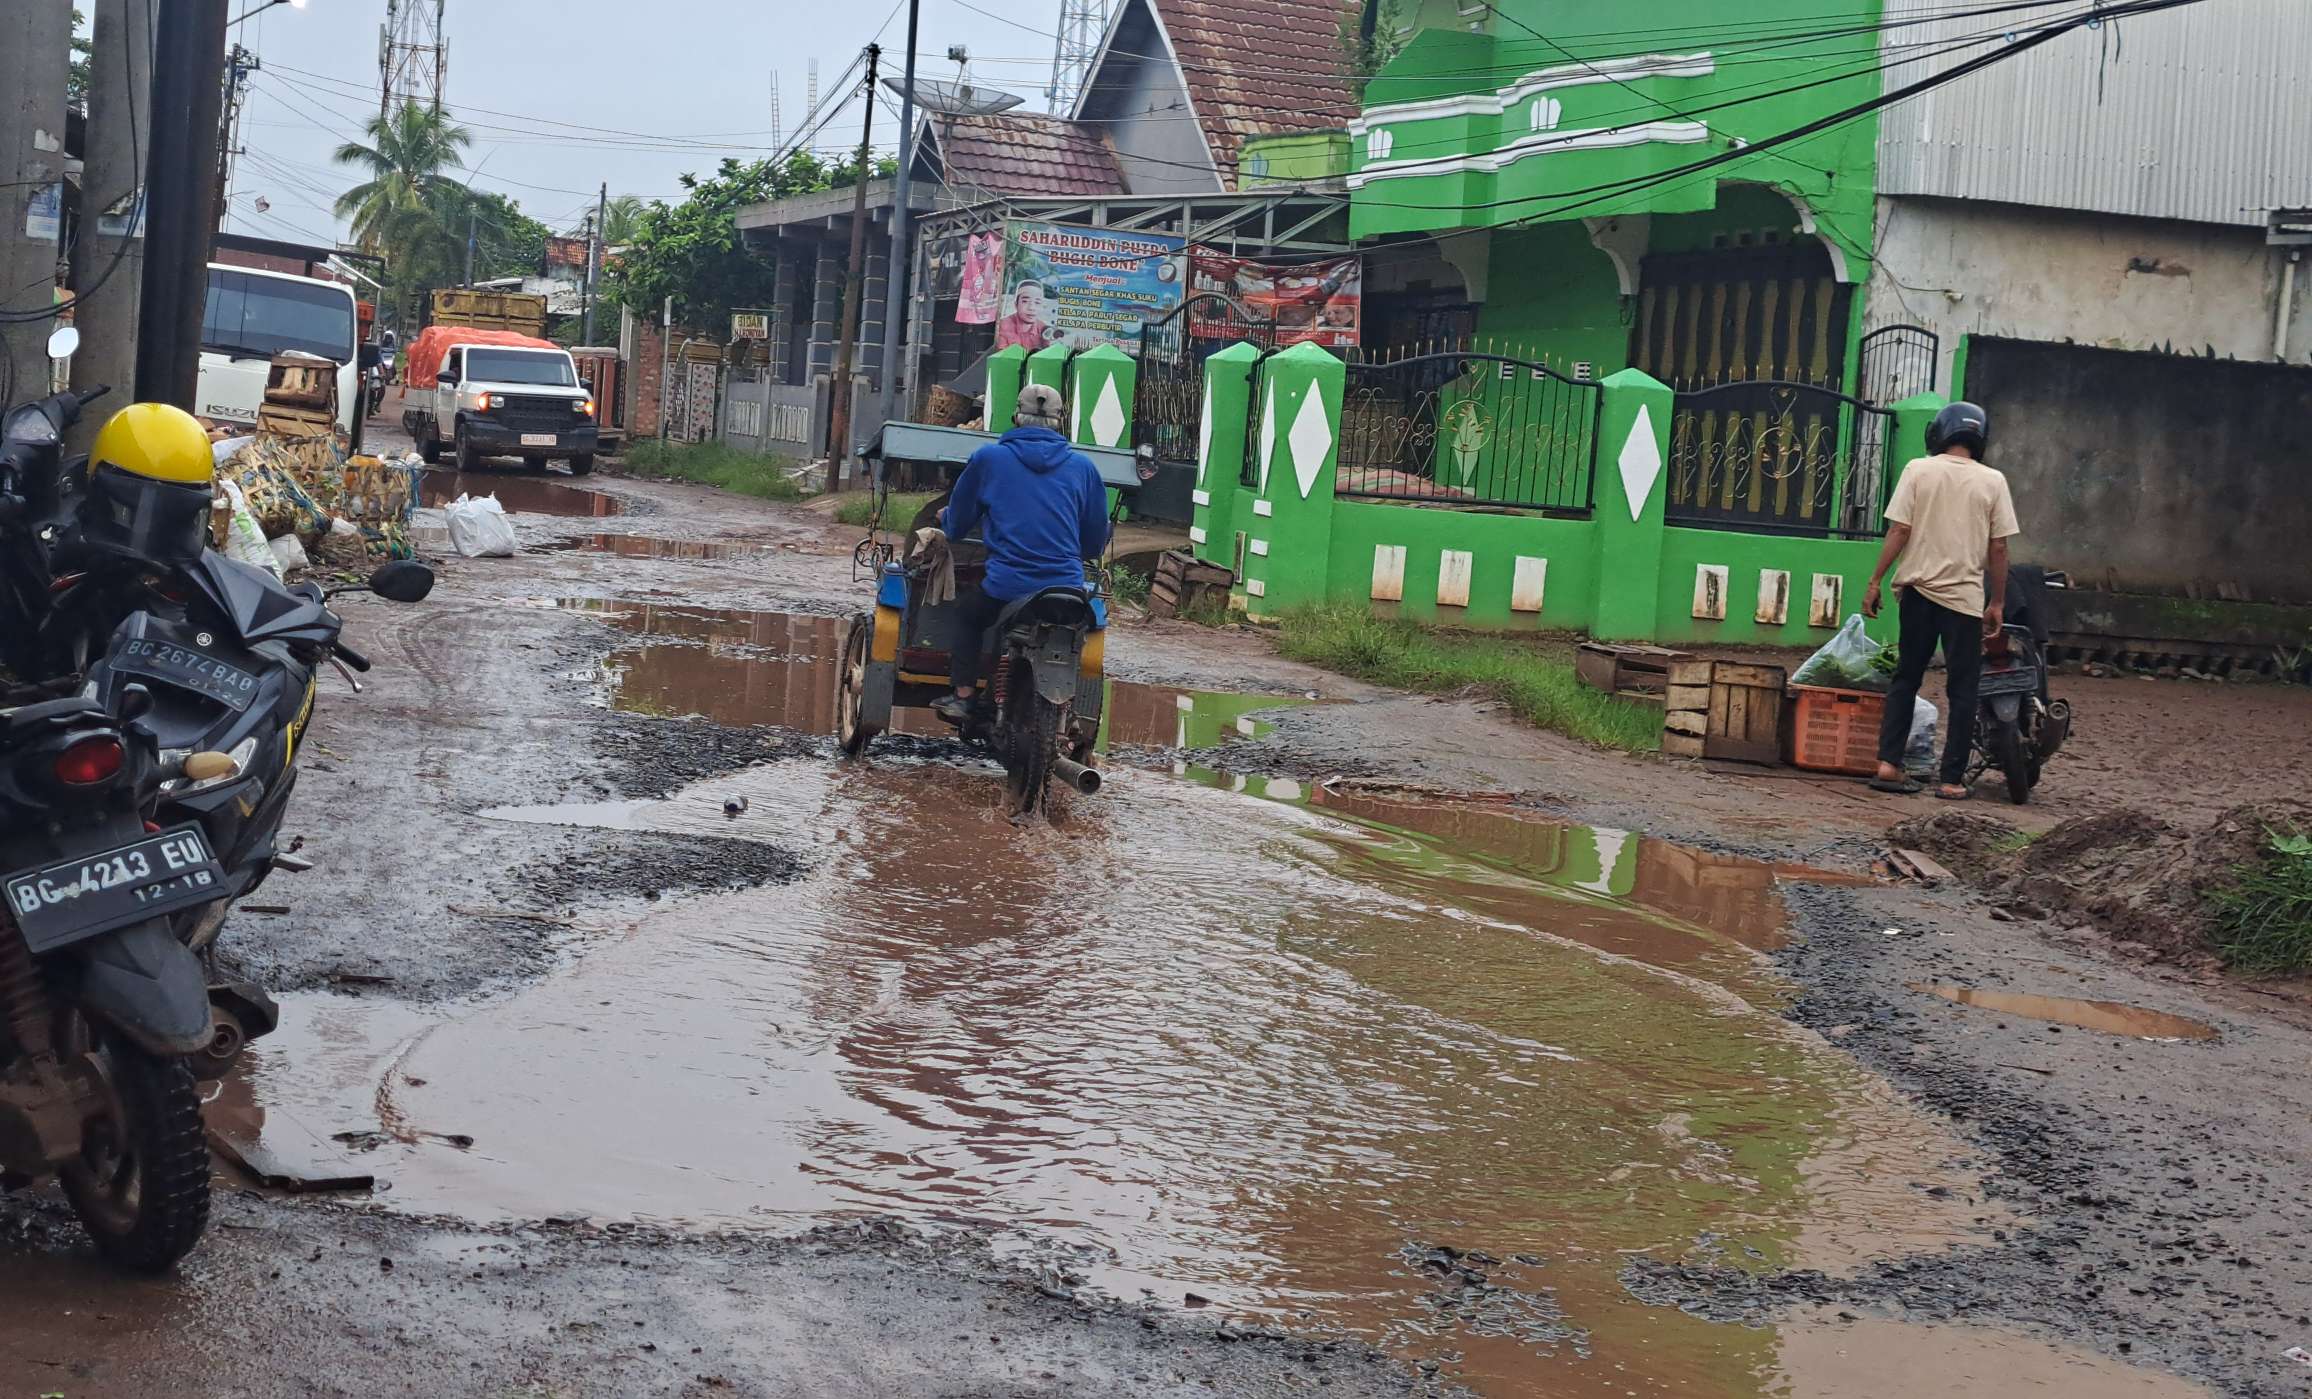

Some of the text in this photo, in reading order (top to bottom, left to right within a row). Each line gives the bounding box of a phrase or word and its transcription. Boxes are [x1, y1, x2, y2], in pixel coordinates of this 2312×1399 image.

[1020, 230, 1169, 257] SAHARUDDIN PUTRA
[1091, 289, 1115, 298] SEGAR
[1116, 291, 1137, 300] KHAS
[1138, 294, 1157, 302] SUKU
[1059, 298, 1101, 308] BUGIS BONE
[1058, 308, 1138, 322] KELAPA PARUT SEGAR
[1057, 319, 1086, 329] KELAPA
[156, 646, 208, 674] 2674
[17, 837, 202, 913] BG 4213 EU
